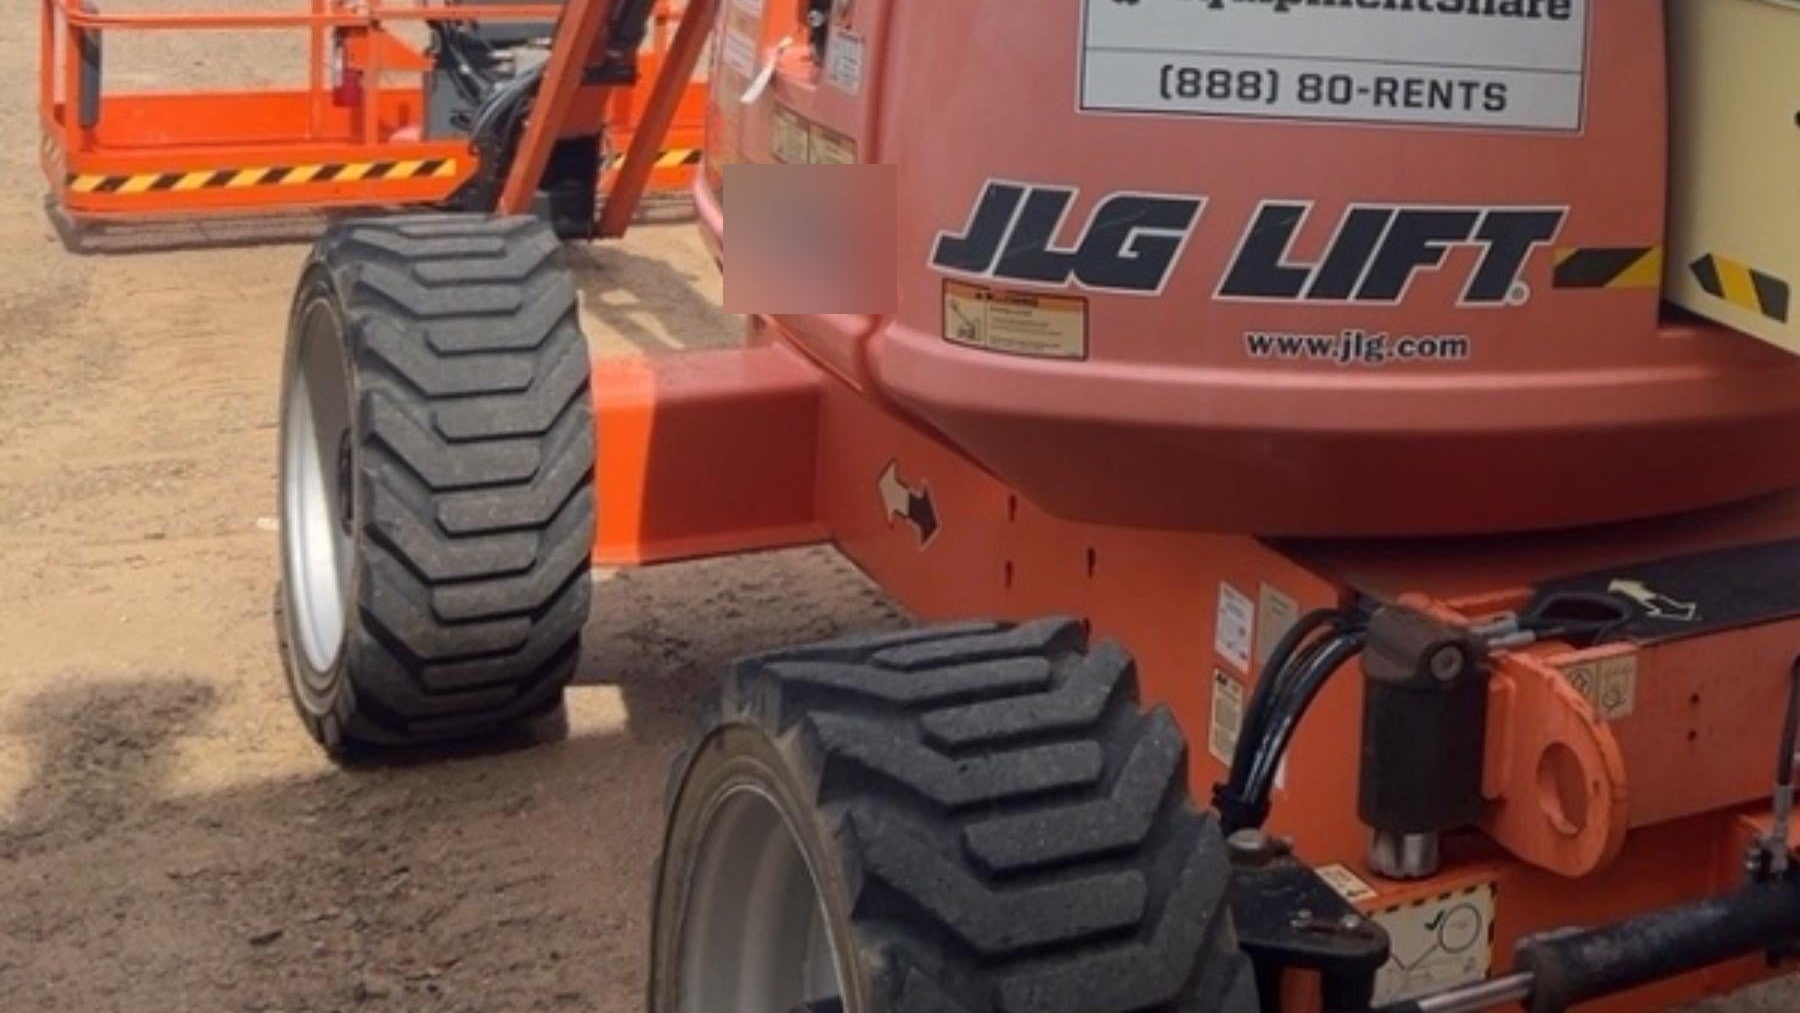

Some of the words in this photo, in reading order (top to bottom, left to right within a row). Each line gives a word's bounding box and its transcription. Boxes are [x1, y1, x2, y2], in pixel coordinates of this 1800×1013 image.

[1160, 64, 1279, 105] (888)
[1297, 73, 1509, 113] 80-RENTS
[928, 179, 1208, 296] JLG
[1246, 330, 1469, 364] www.jlg.com
